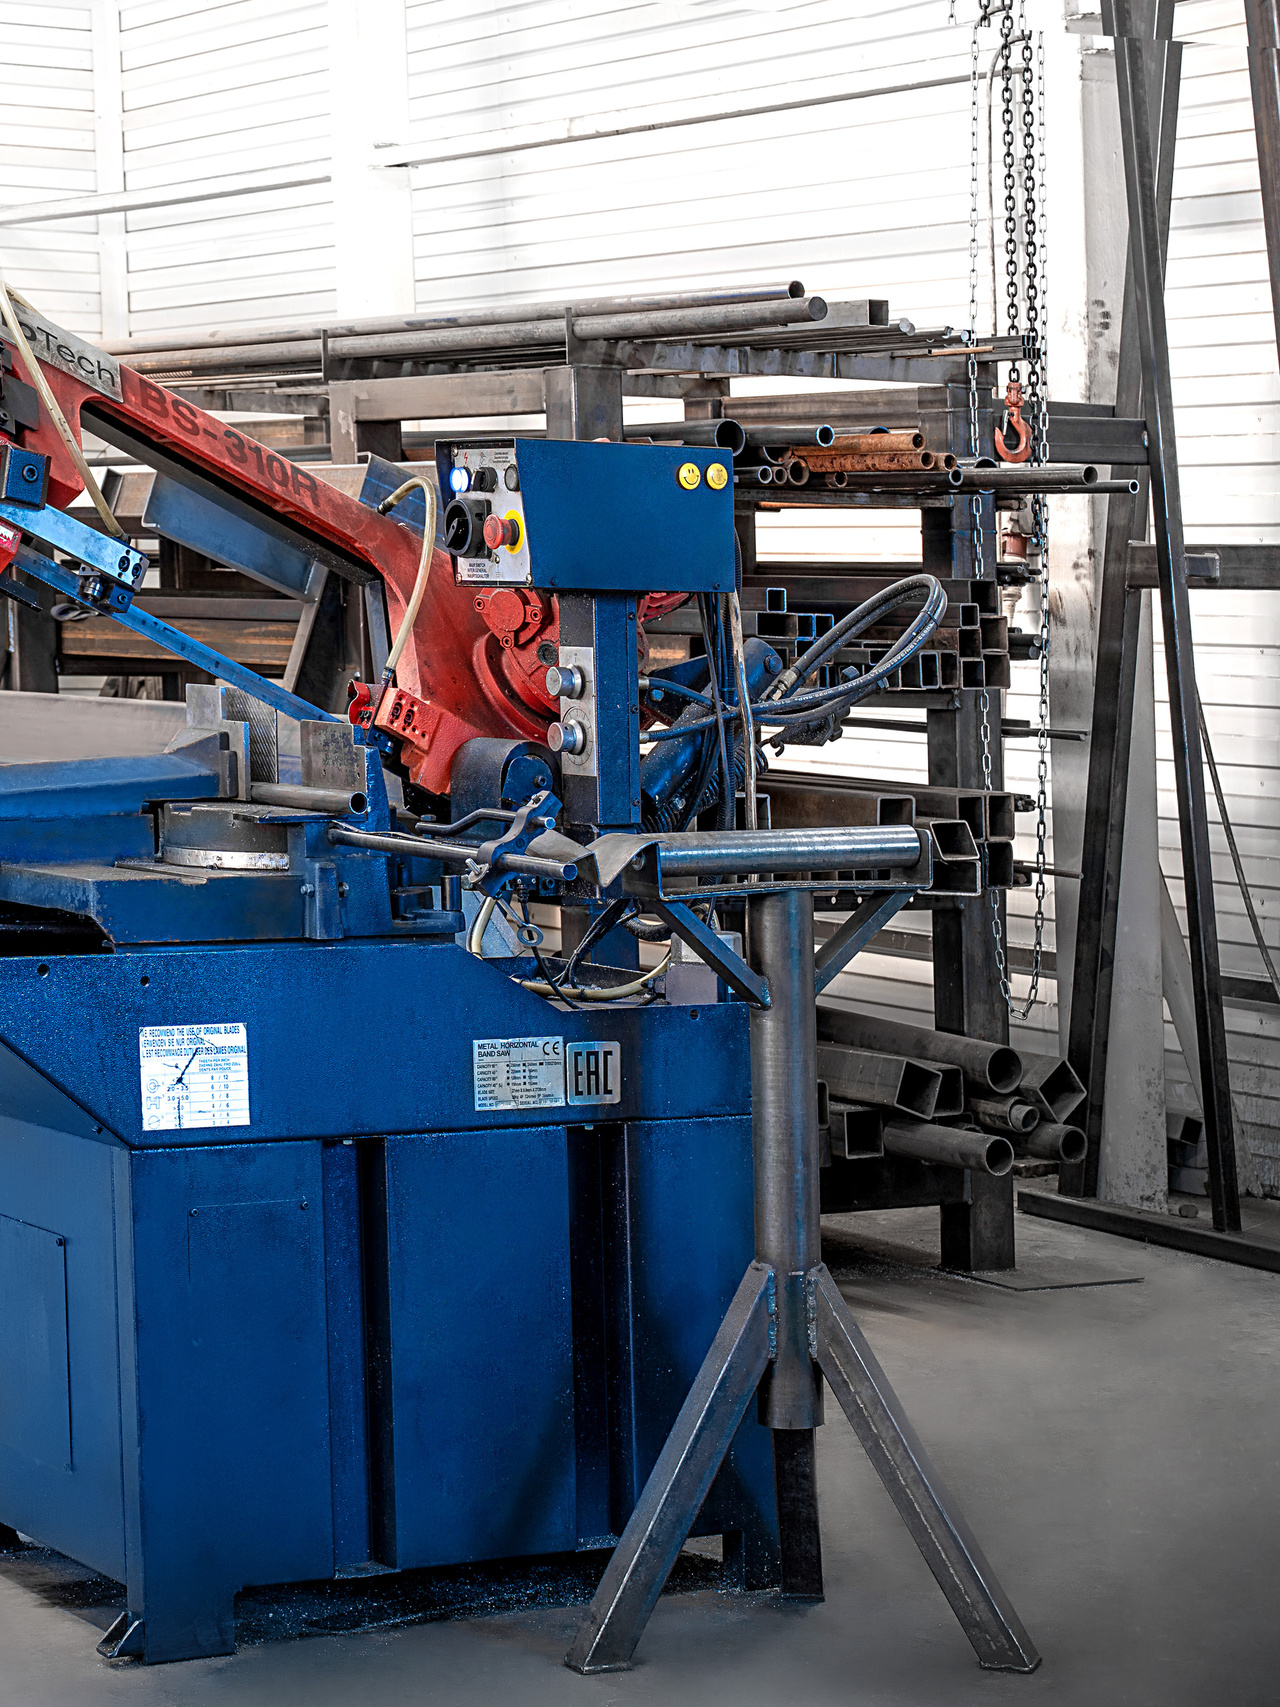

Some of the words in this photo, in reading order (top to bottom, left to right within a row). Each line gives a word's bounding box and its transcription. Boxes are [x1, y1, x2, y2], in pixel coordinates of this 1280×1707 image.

[139, 378, 321, 508] BS-310R
[149, 1028, 176, 1038] RECOMMEND
[177, 1027, 185, 1036] THE
[186, 1026, 195, 1035] USE
[196, 1026, 202, 1035] OF
[203, 1026, 222, 1035] ORIGINAL
[224, 1025, 240, 1034] BLADES
[176, 1037, 185, 1047] NUR
[500, 1041, 540, 1049] HORIZONTAL
[227, 1045, 247, 1054] ORIGINAL
[478, 1050, 496, 1058] BAND
[496, 1049, 510, 1057] SAW
[542, 1041, 560, 1056] CE
[573, 1050, 613, 1096] EAC
